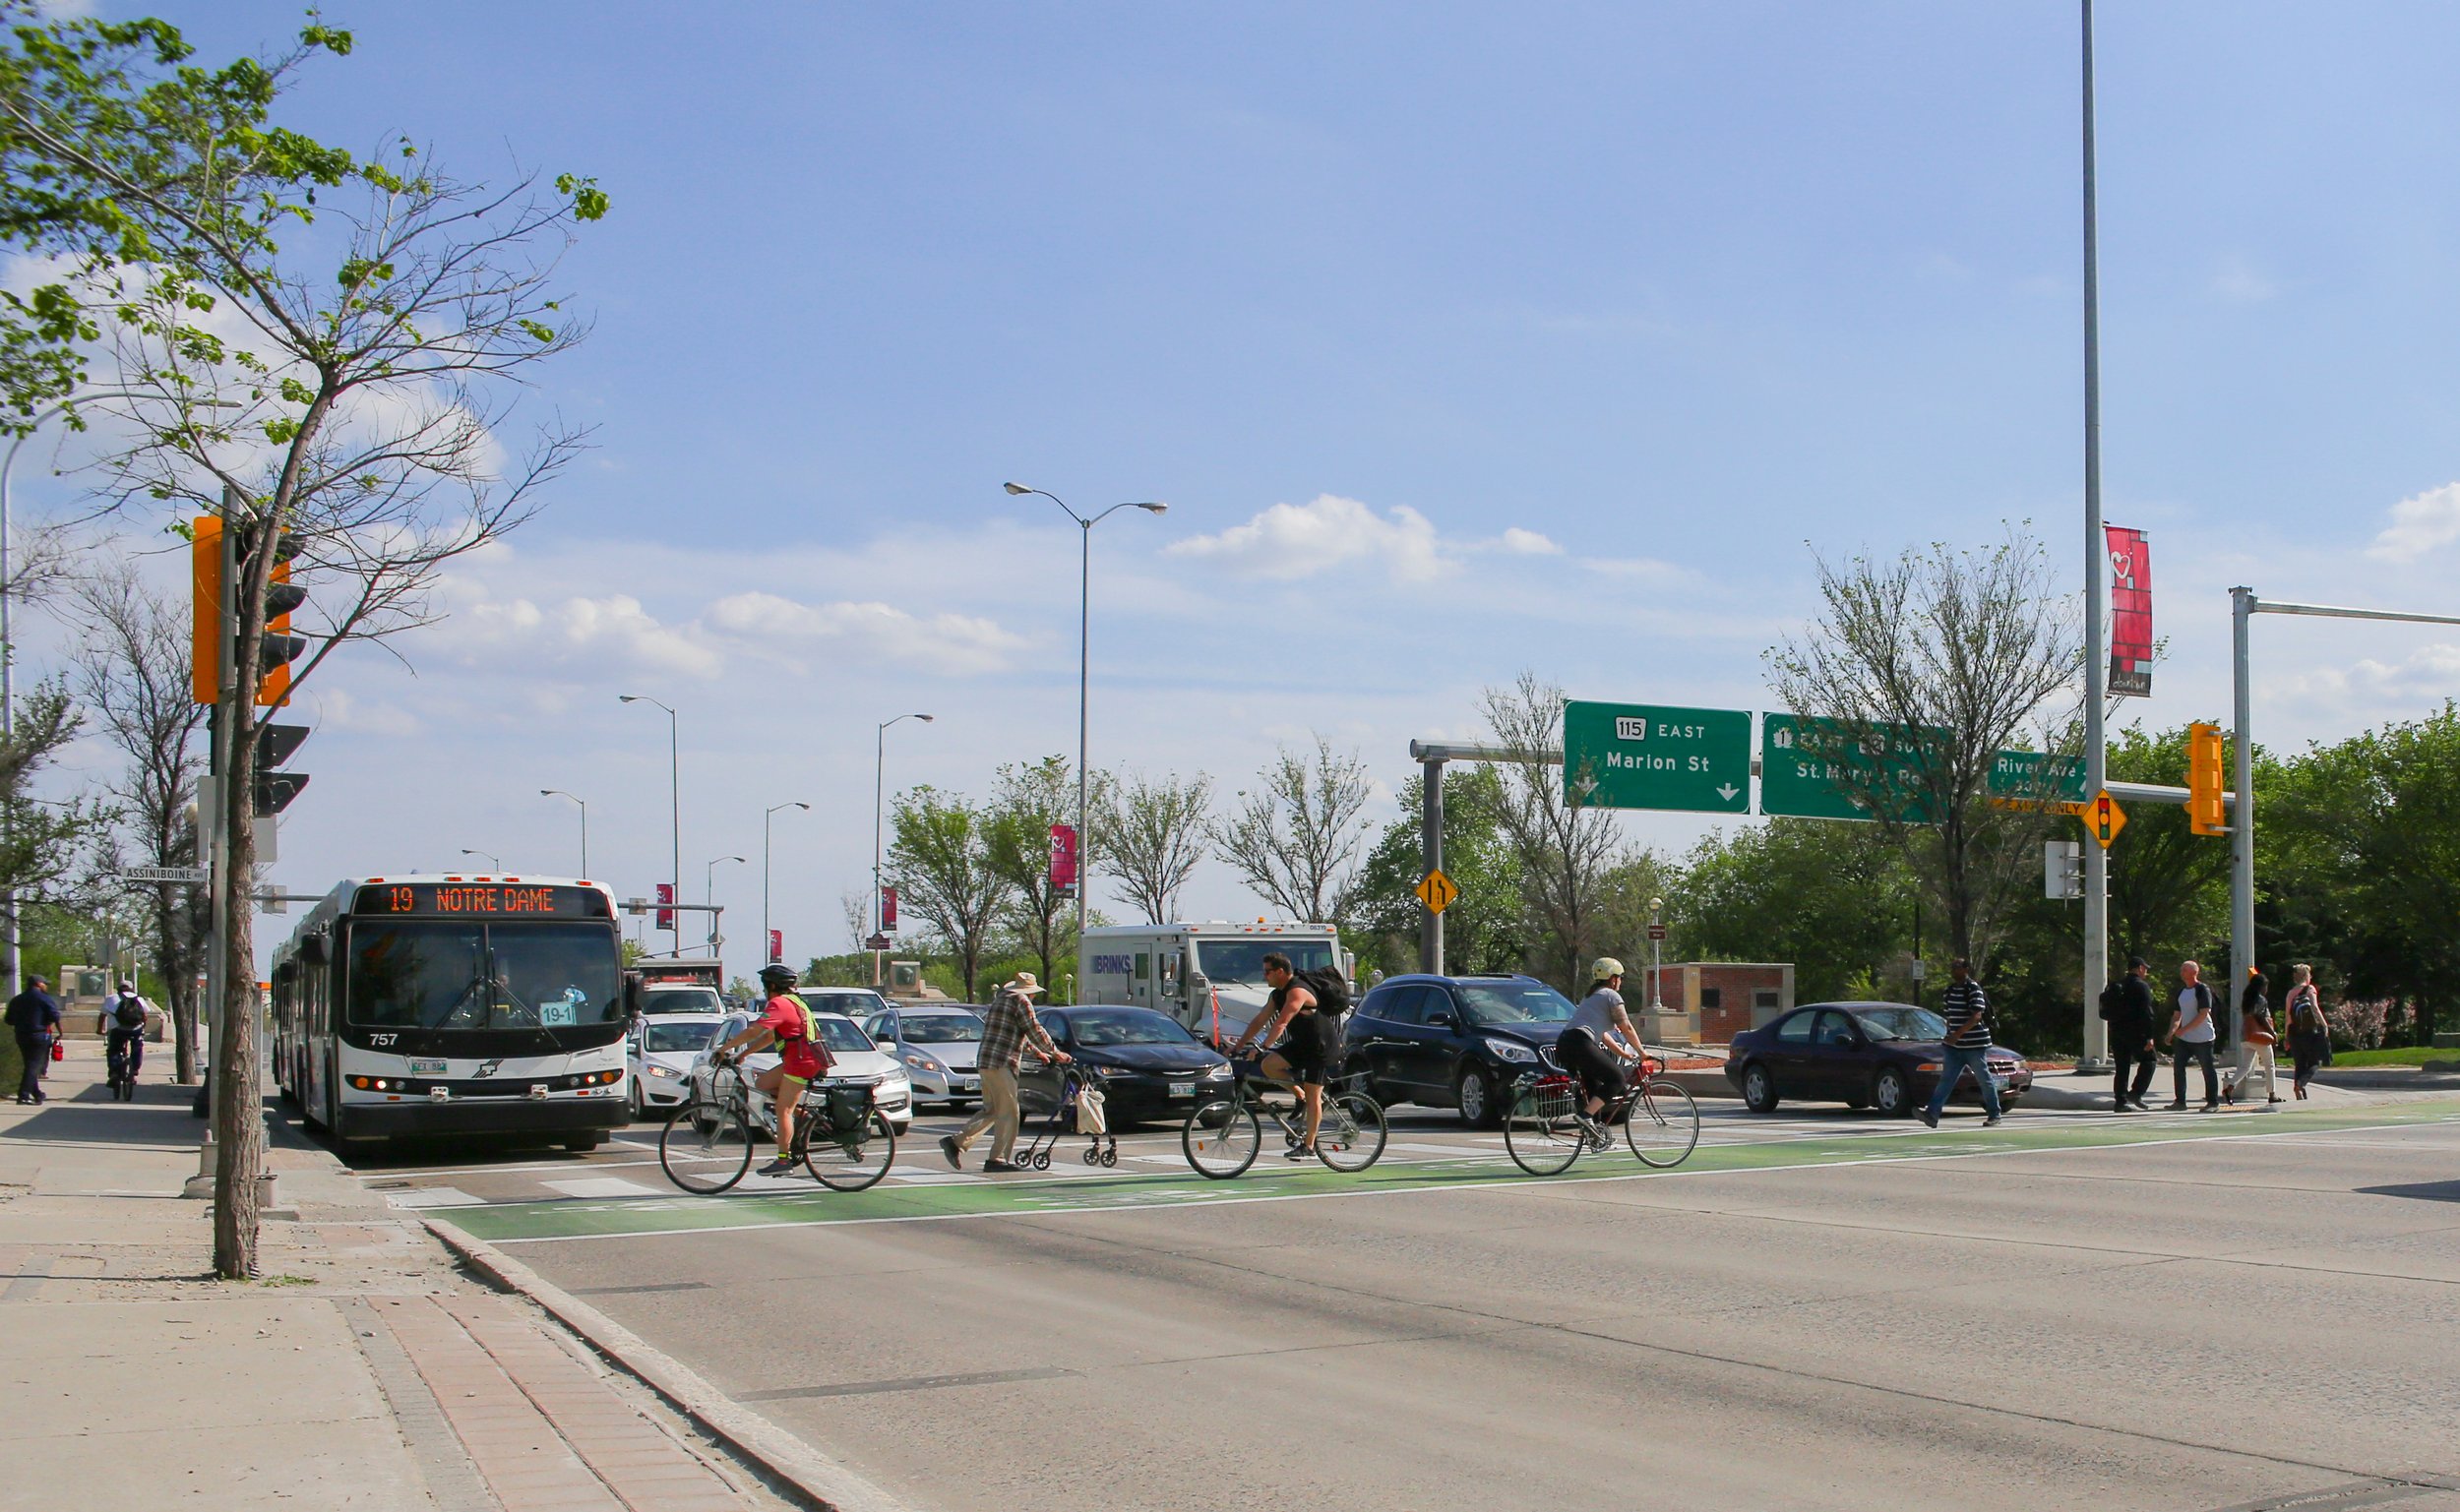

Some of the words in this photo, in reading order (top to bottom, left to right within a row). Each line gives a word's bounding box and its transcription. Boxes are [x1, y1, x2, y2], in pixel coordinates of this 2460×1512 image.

[1620, 721, 1642, 736] 115
[1658, 724, 1705, 739] EAST
[1607, 752, 1676, 770] Marion
[1689, 756, 1709, 771] St
[1797, 761, 1820, 779] St.
[1998, 757, 2039, 774] River
[2048, 765, 2077, 778] Ave
[127, 868, 192, 879] ASSINIBOINE
[391, 887, 413, 911] 19
[437, 887, 498, 911] NOTRE
[504, 888, 554, 911] DAME
[1095, 954, 1131, 974] BRINKS
[543, 1006, 571, 1022] 19-1
[370, 1033, 399, 1046] 757
